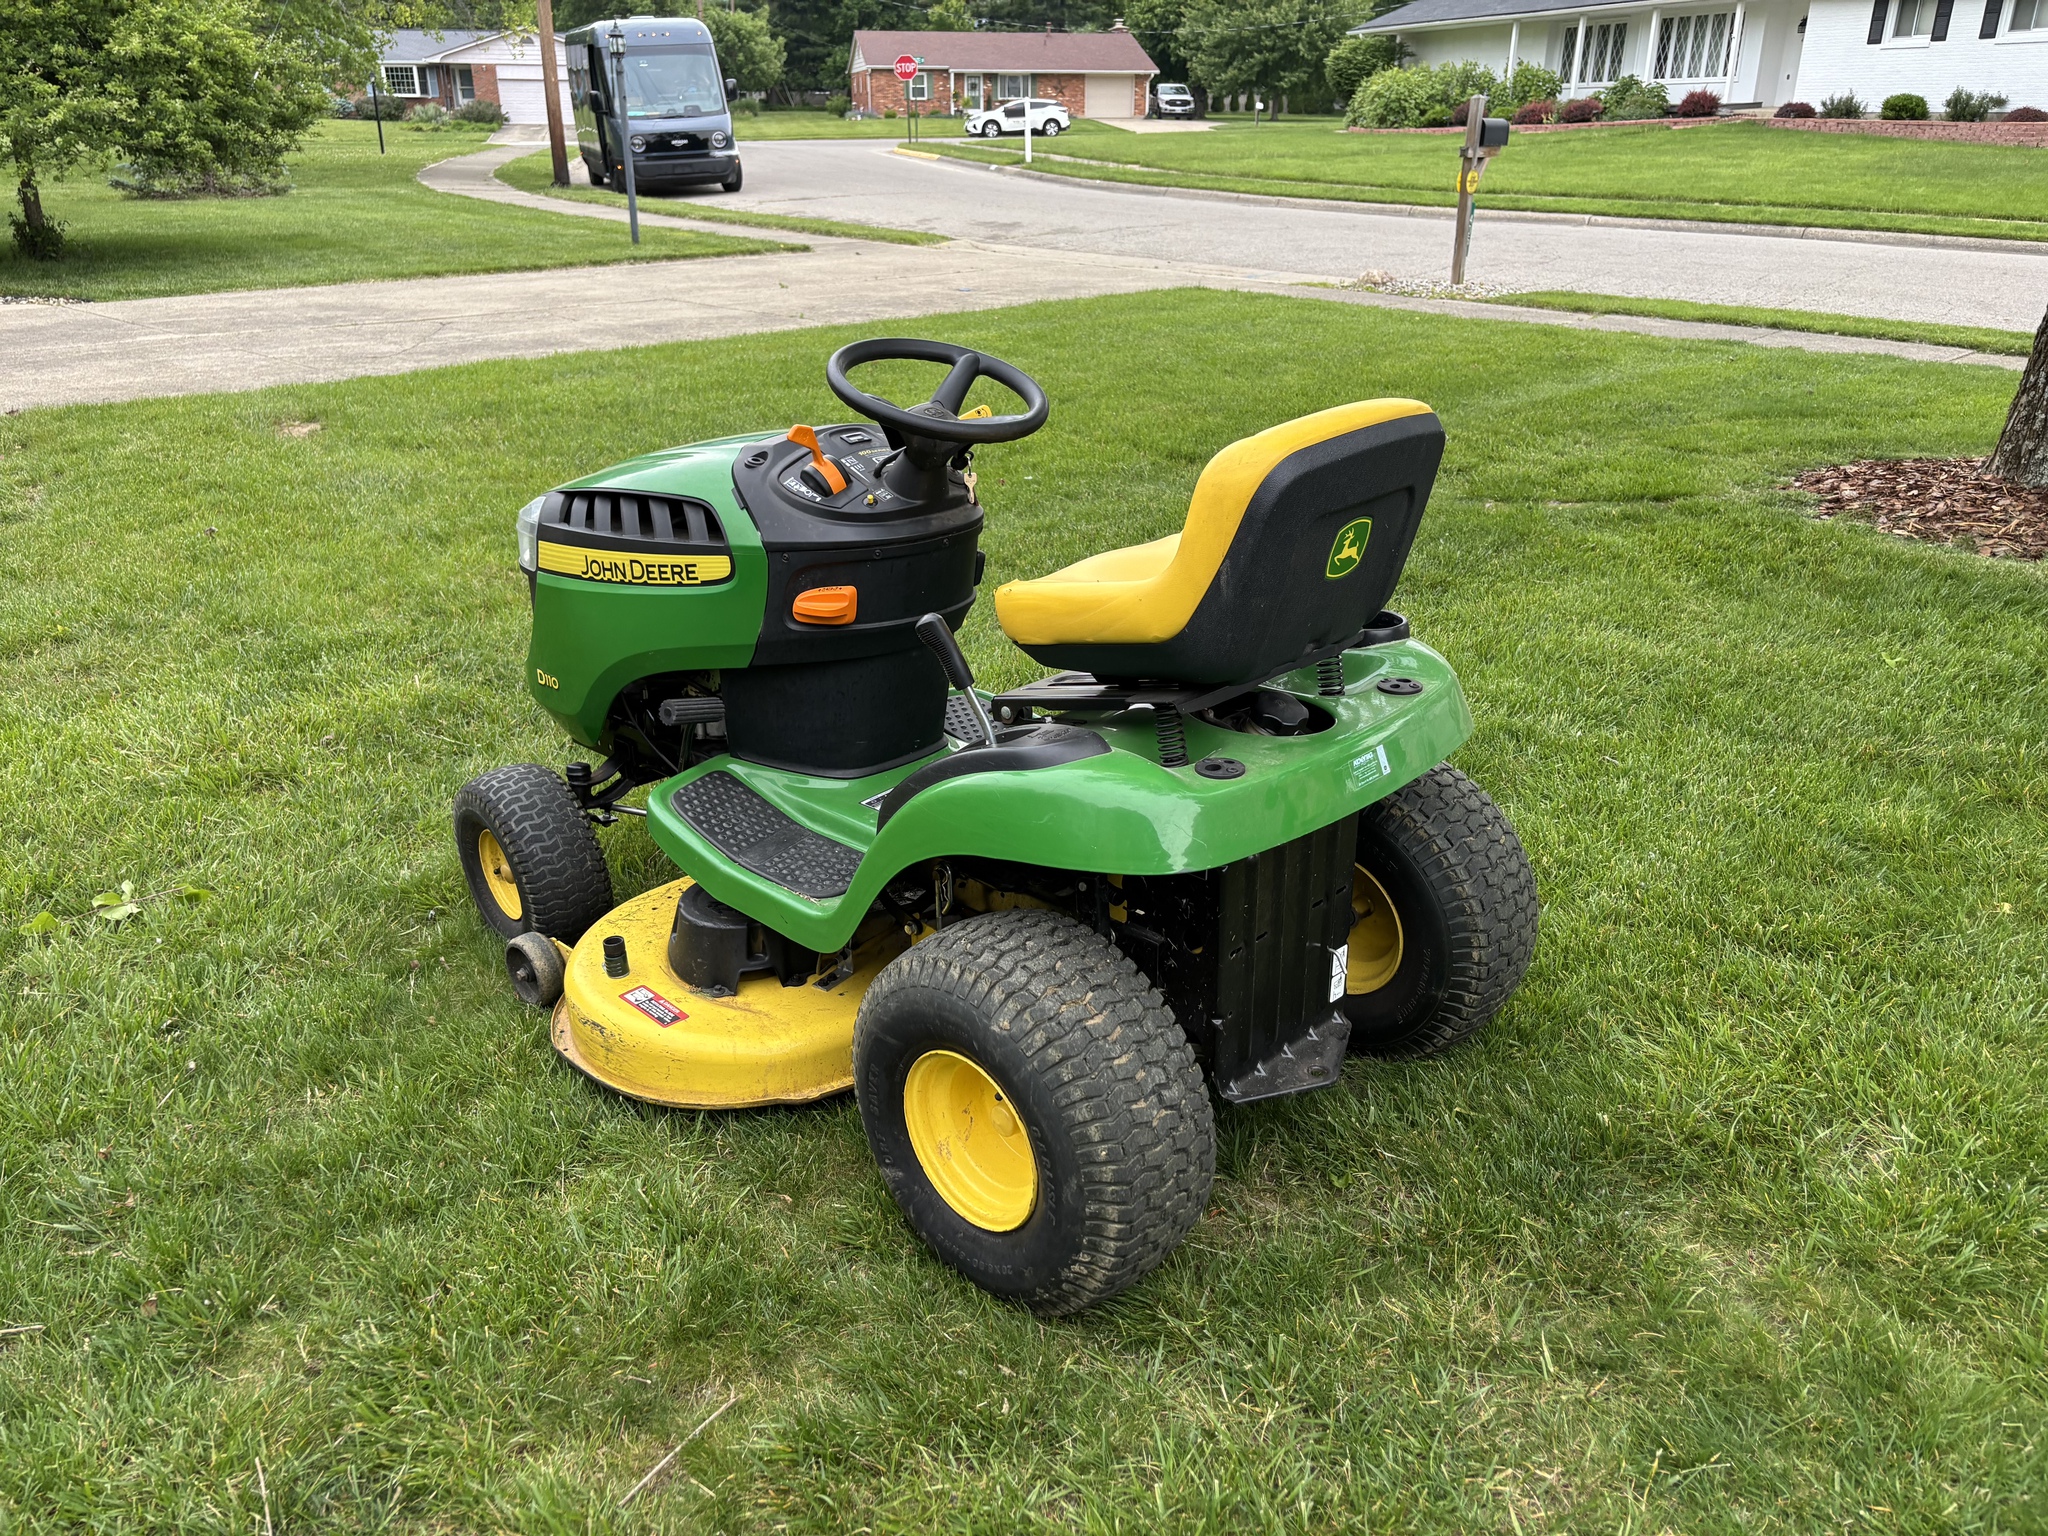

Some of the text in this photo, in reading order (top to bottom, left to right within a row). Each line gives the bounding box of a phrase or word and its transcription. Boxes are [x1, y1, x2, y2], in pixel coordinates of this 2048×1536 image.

[896, 62, 916, 73] STOP
[581, 555, 699, 582] JOHN DEERE
[536, 668, 559, 690] D110
